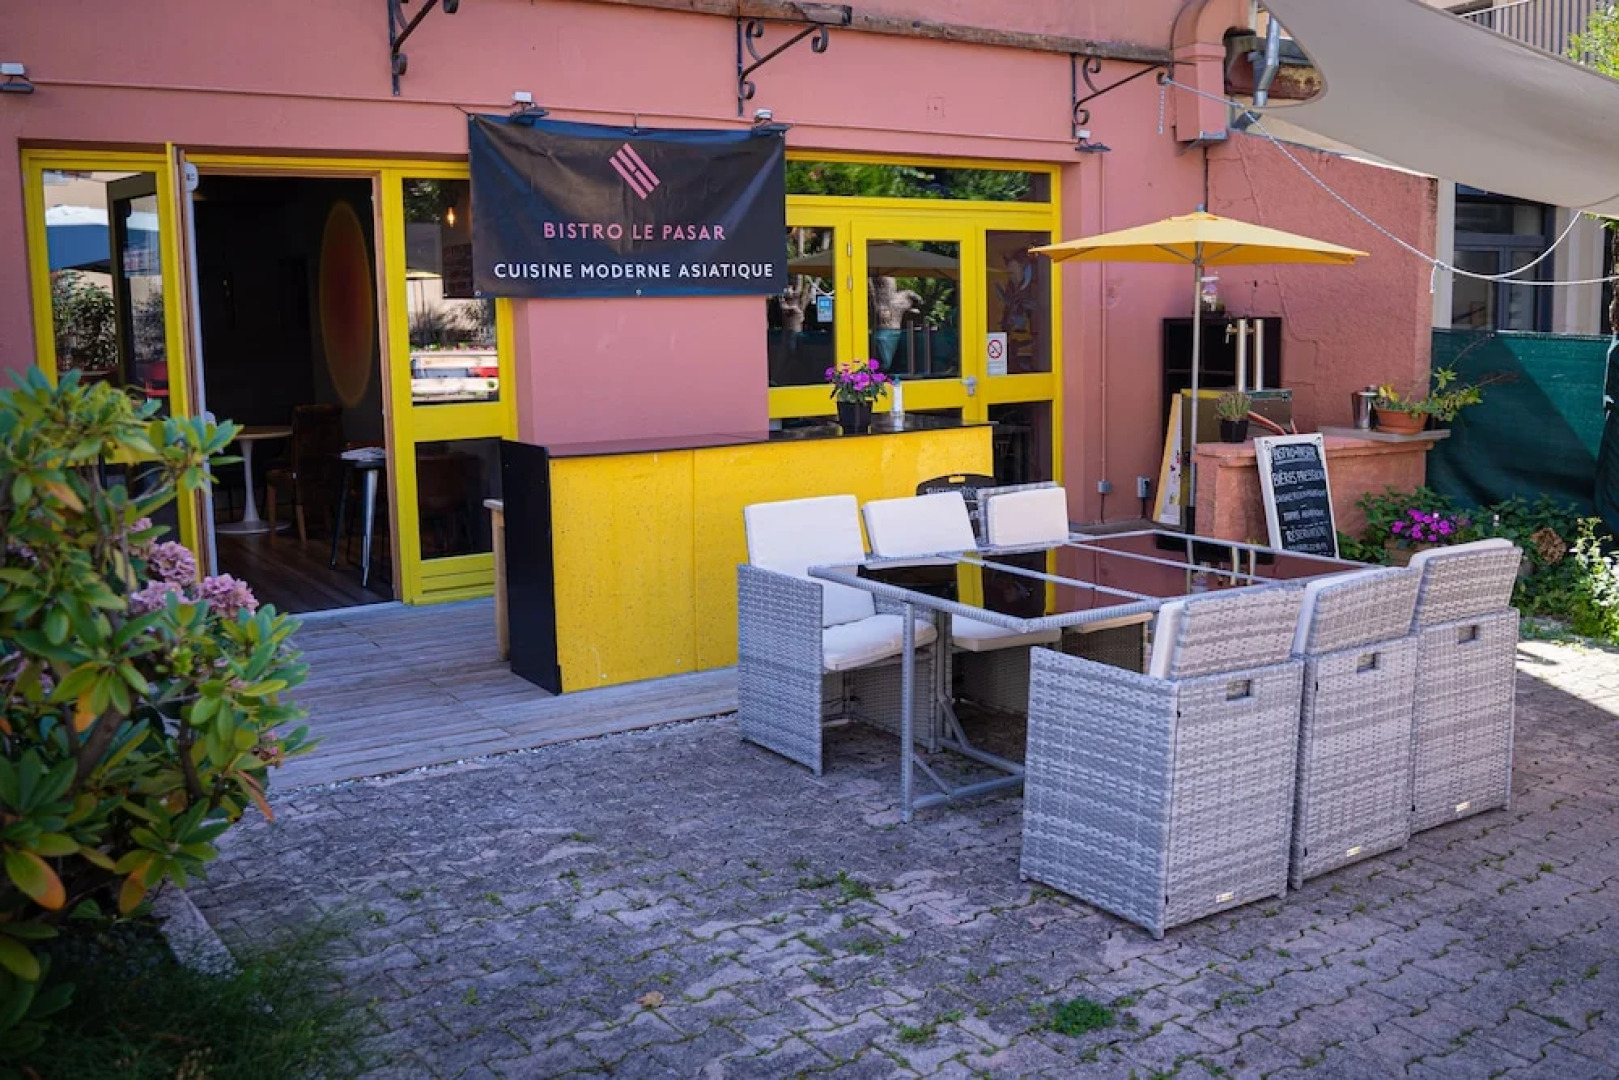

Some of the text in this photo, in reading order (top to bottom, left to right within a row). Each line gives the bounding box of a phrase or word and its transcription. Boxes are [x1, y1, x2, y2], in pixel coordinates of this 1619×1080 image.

[543, 222, 726, 240] BISTRO LE PASAR
[494, 263, 773, 279] CUISINE MODERNE ASIATIQUE
